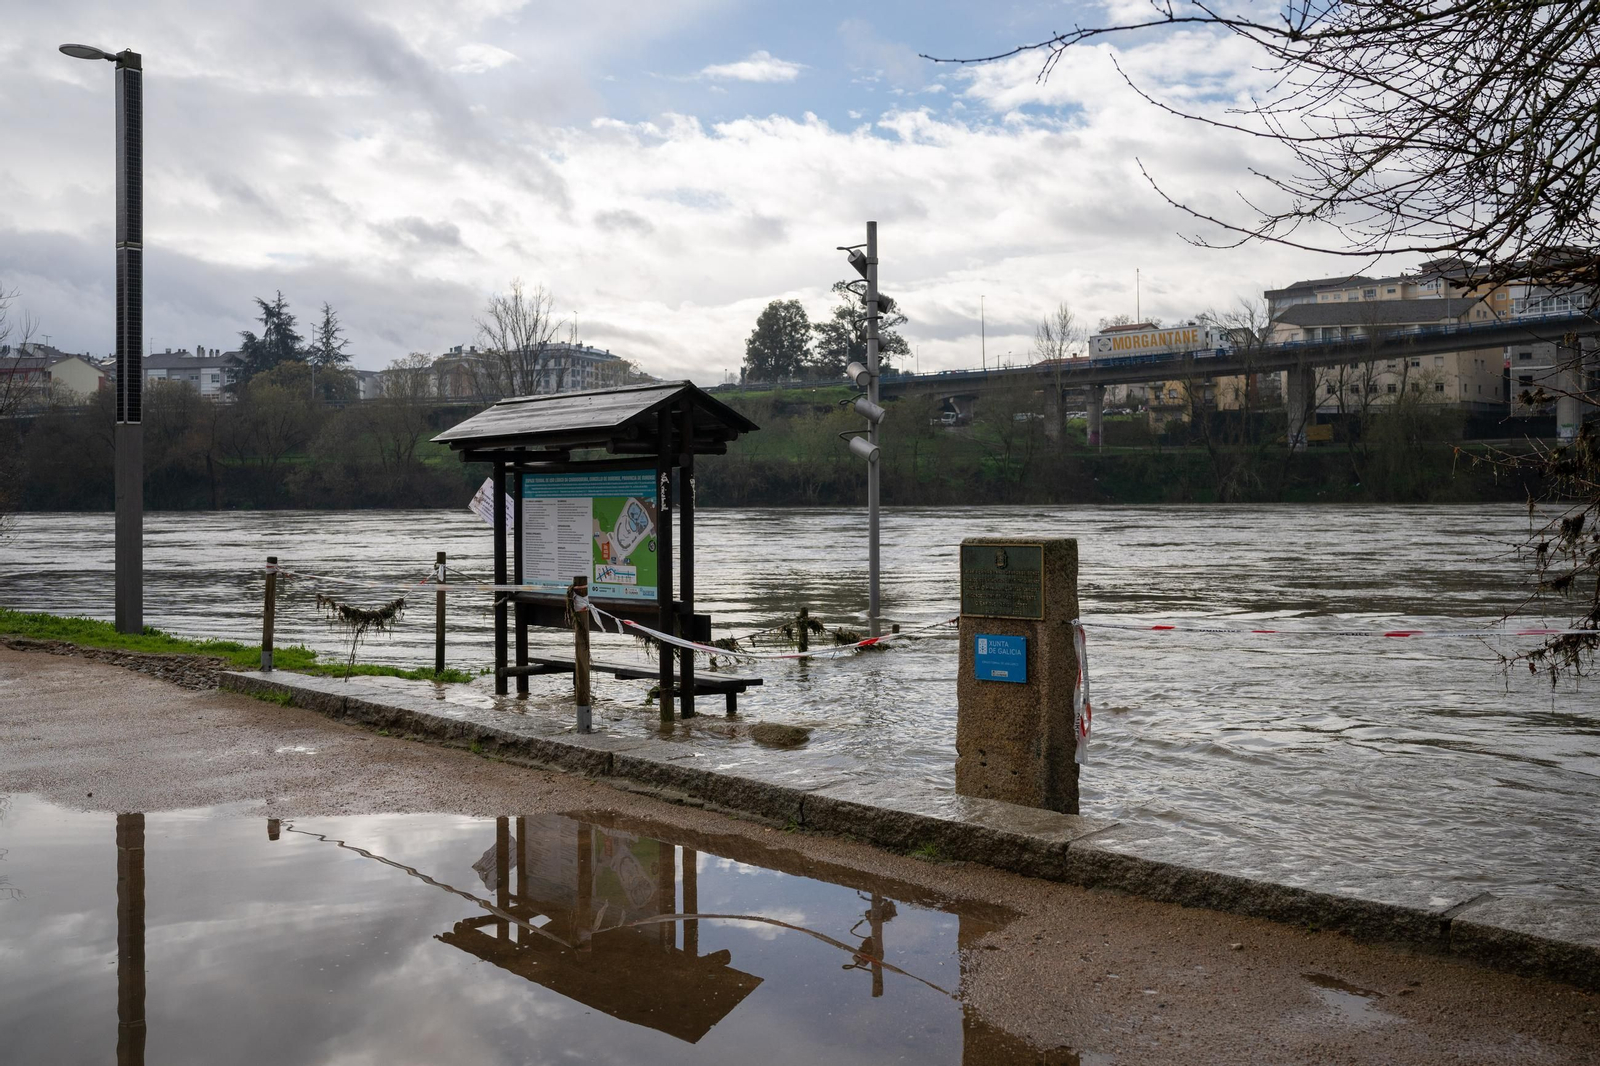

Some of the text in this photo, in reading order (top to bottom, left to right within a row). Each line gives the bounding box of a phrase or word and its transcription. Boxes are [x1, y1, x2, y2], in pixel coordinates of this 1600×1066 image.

[1112, 329, 1198, 350] MORGANTANE
[988, 640, 1009, 648] XUNTA
[997, 647, 1022, 656] GALICIA
